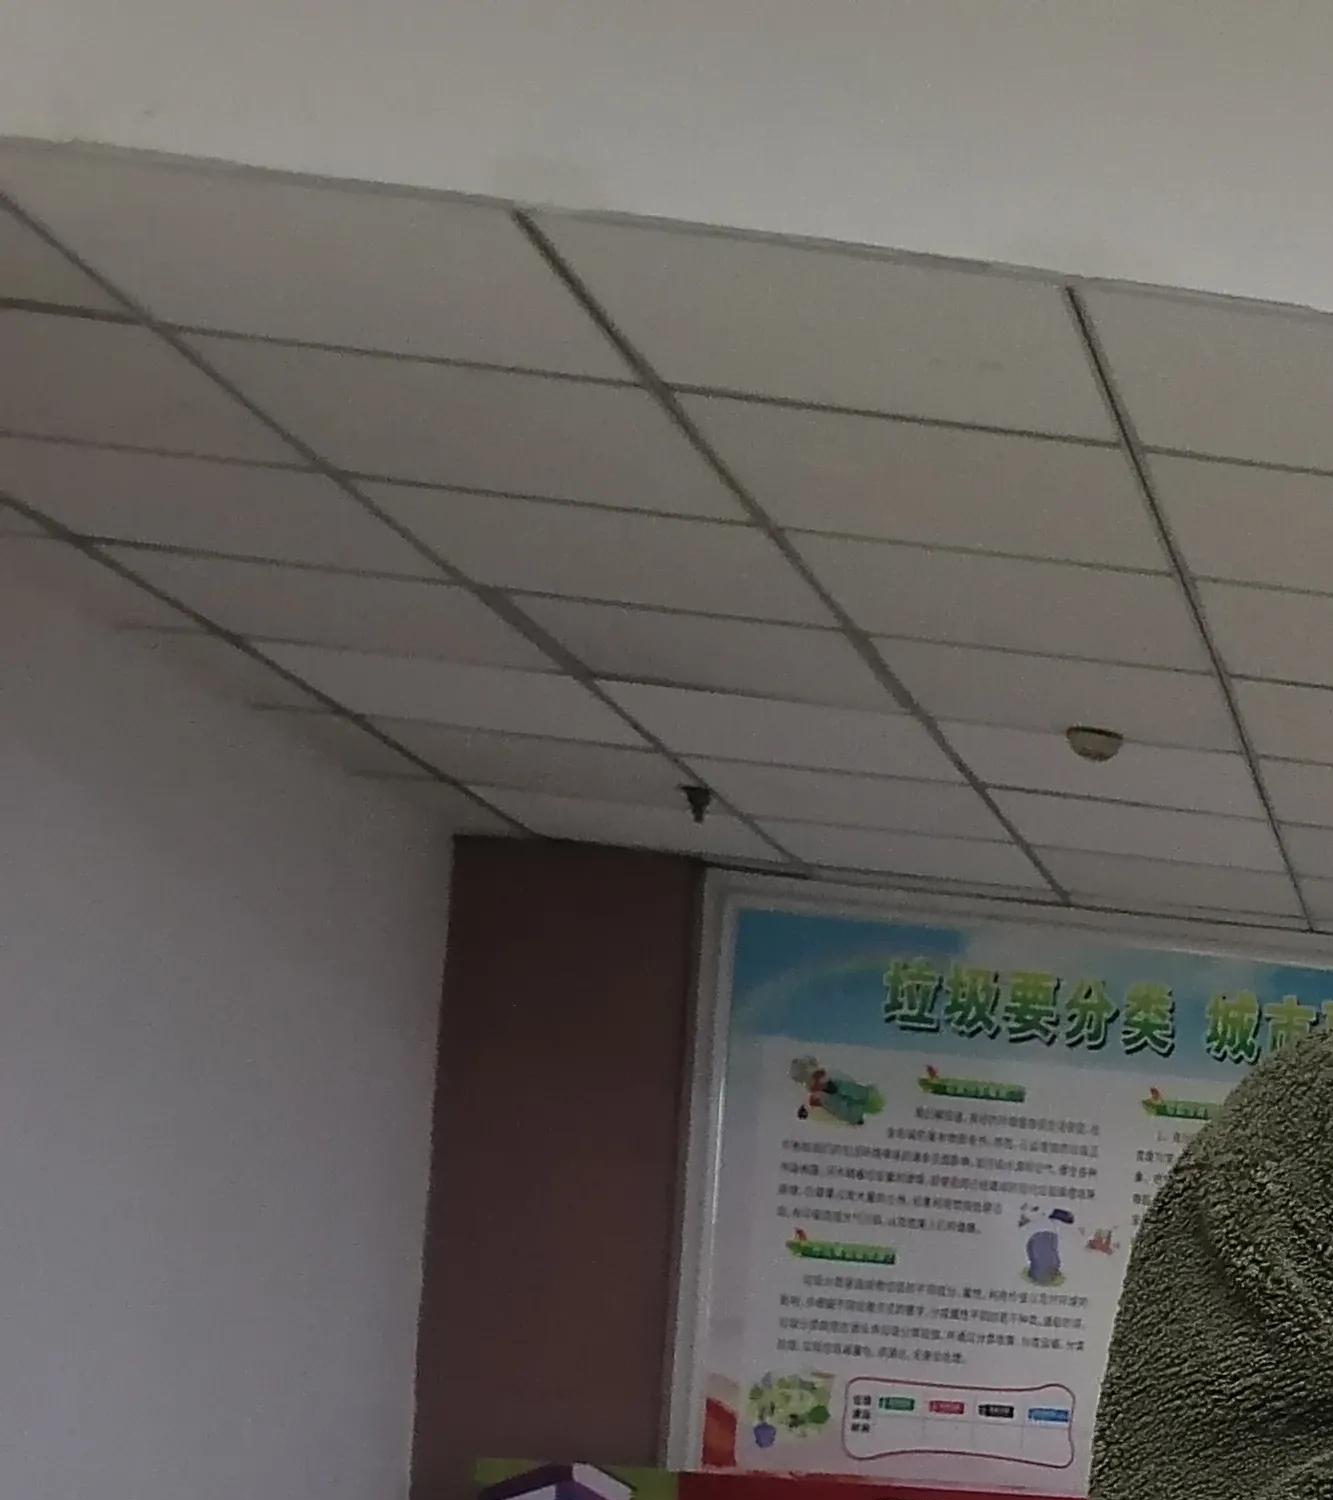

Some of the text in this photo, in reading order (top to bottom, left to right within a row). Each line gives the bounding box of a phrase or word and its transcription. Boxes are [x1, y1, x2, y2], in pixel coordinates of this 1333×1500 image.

[883, 961, 1176, 1057] 垃圾要分类
